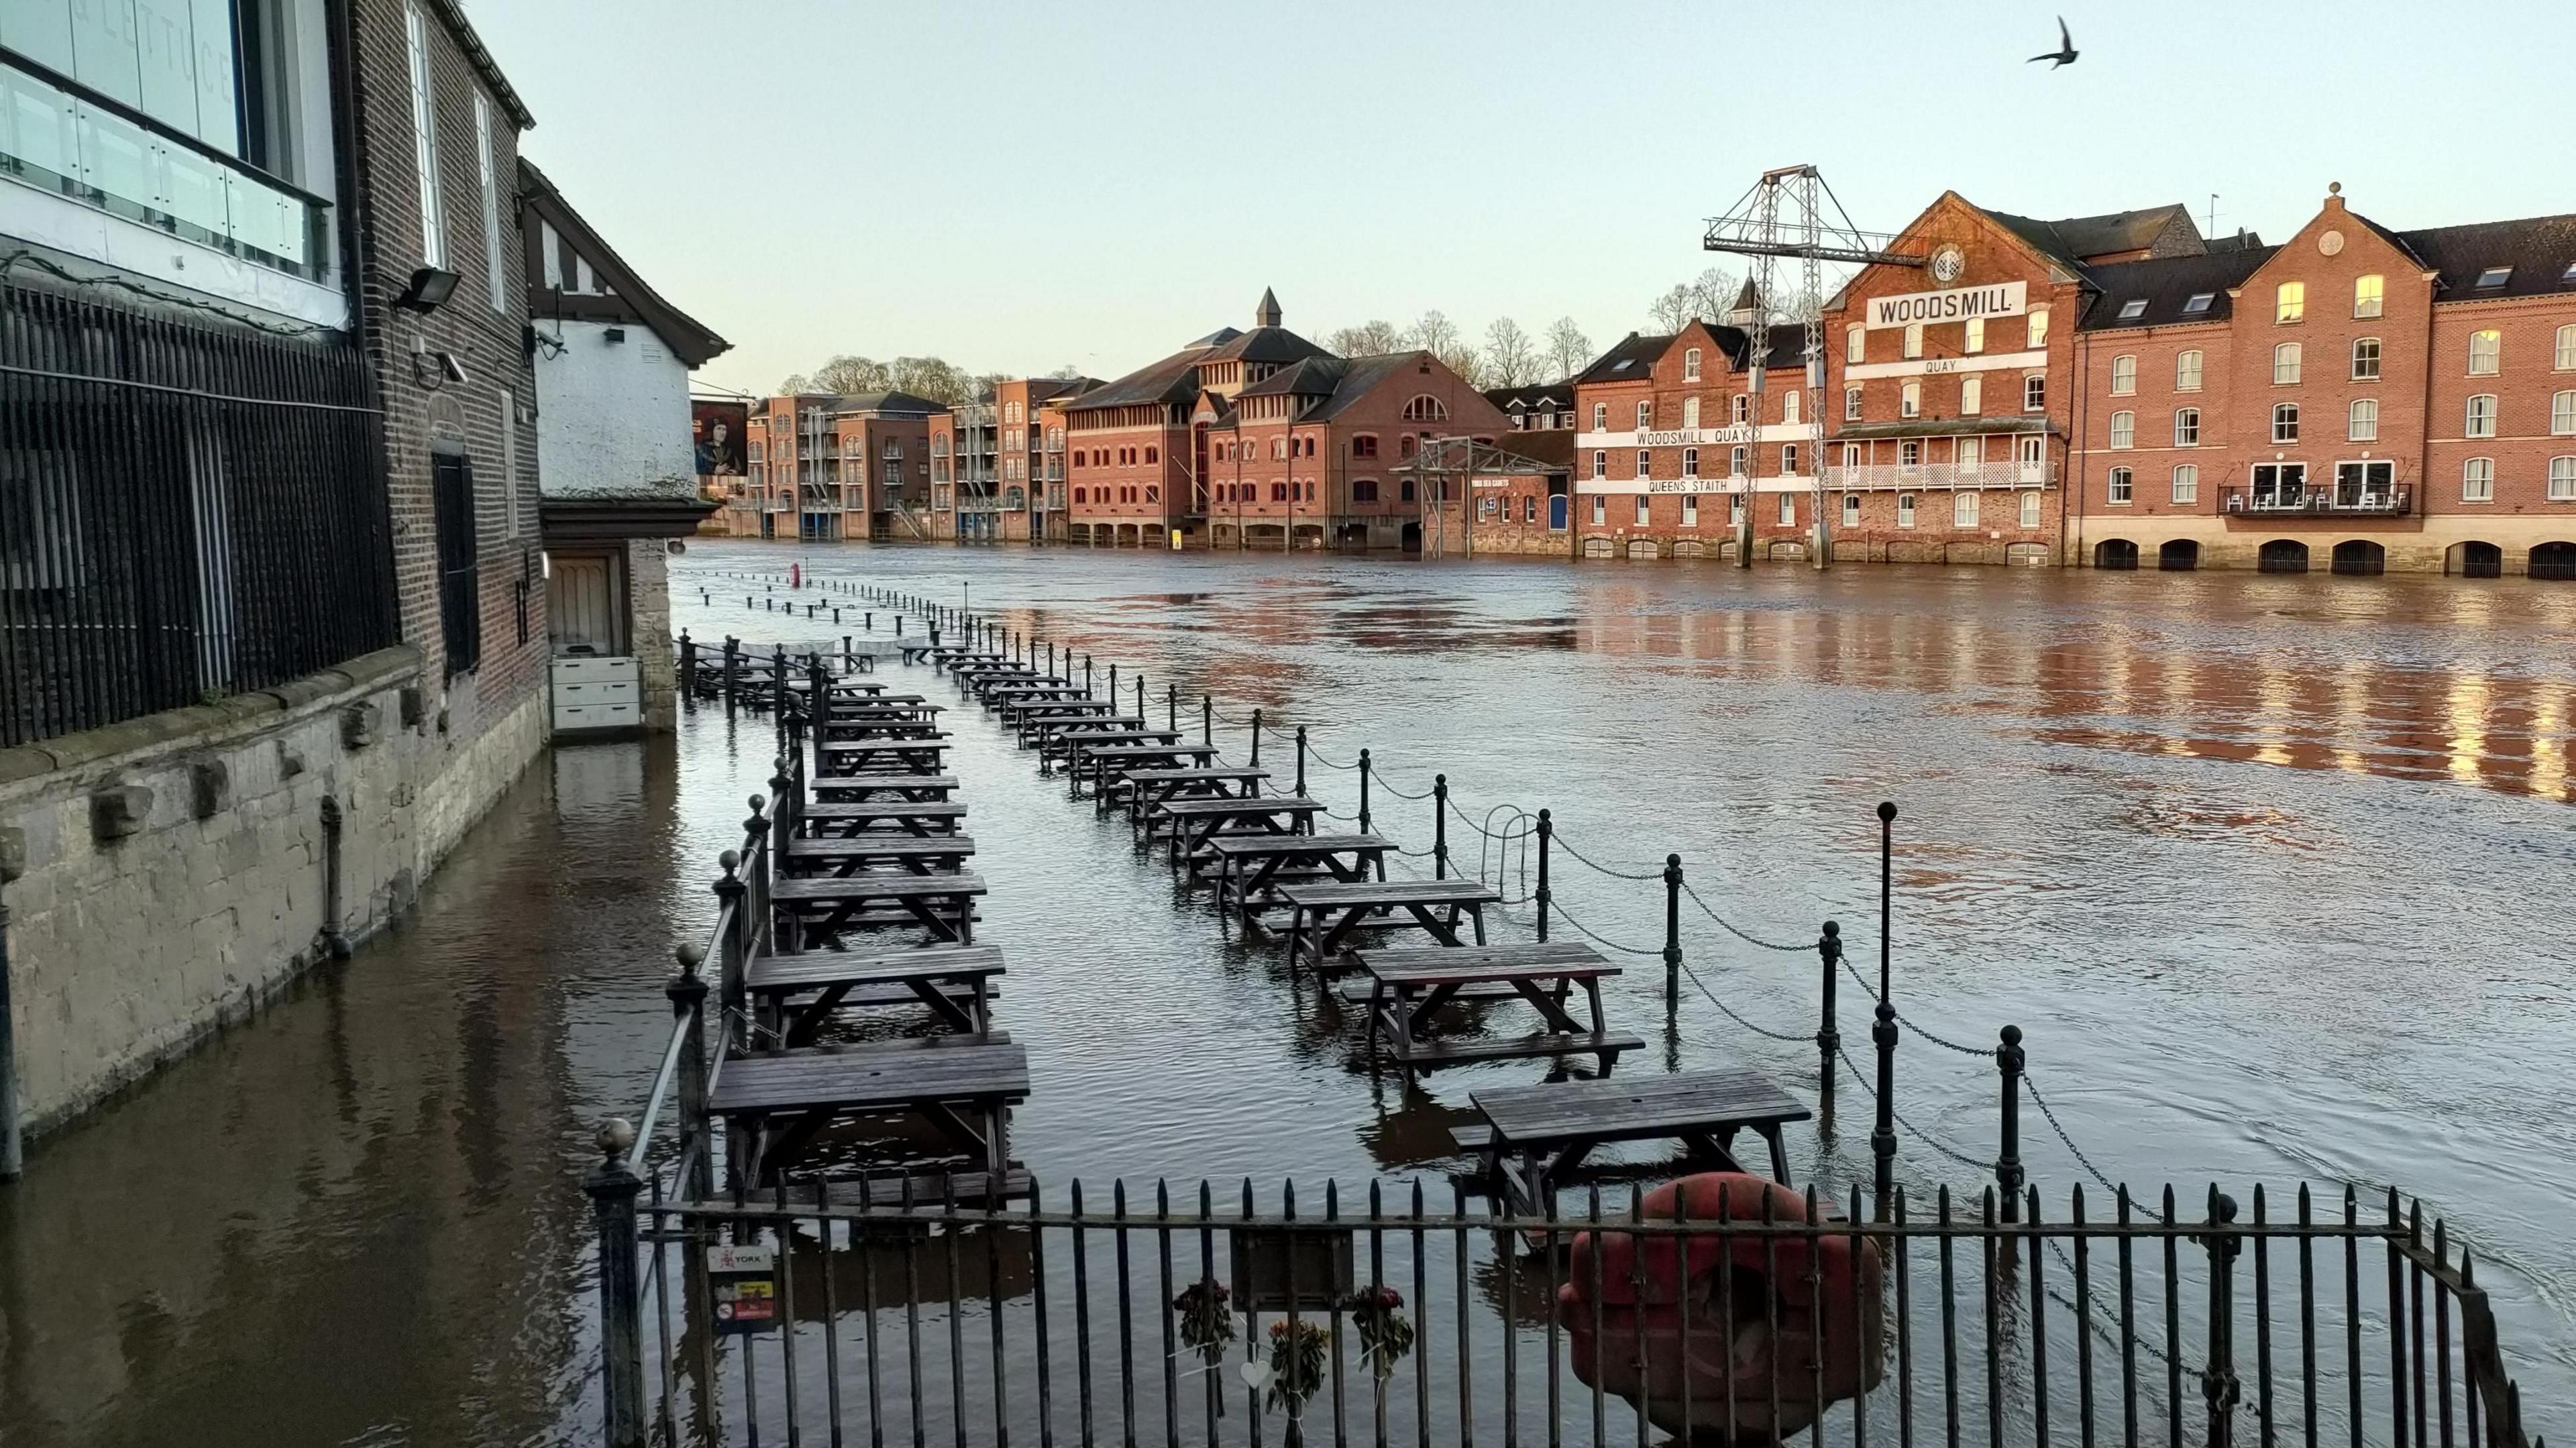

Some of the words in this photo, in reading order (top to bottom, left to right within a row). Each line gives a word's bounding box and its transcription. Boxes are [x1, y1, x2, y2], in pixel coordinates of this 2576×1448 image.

[1925, 360, 1957, 373] QUAY
[1637, 431, 1706, 445] WOODSMILL
[1715, 429, 1748, 442] QUAY
[1649, 481, 1686, 492] QUEENS
[1693, 480, 1727, 492] STAITH
